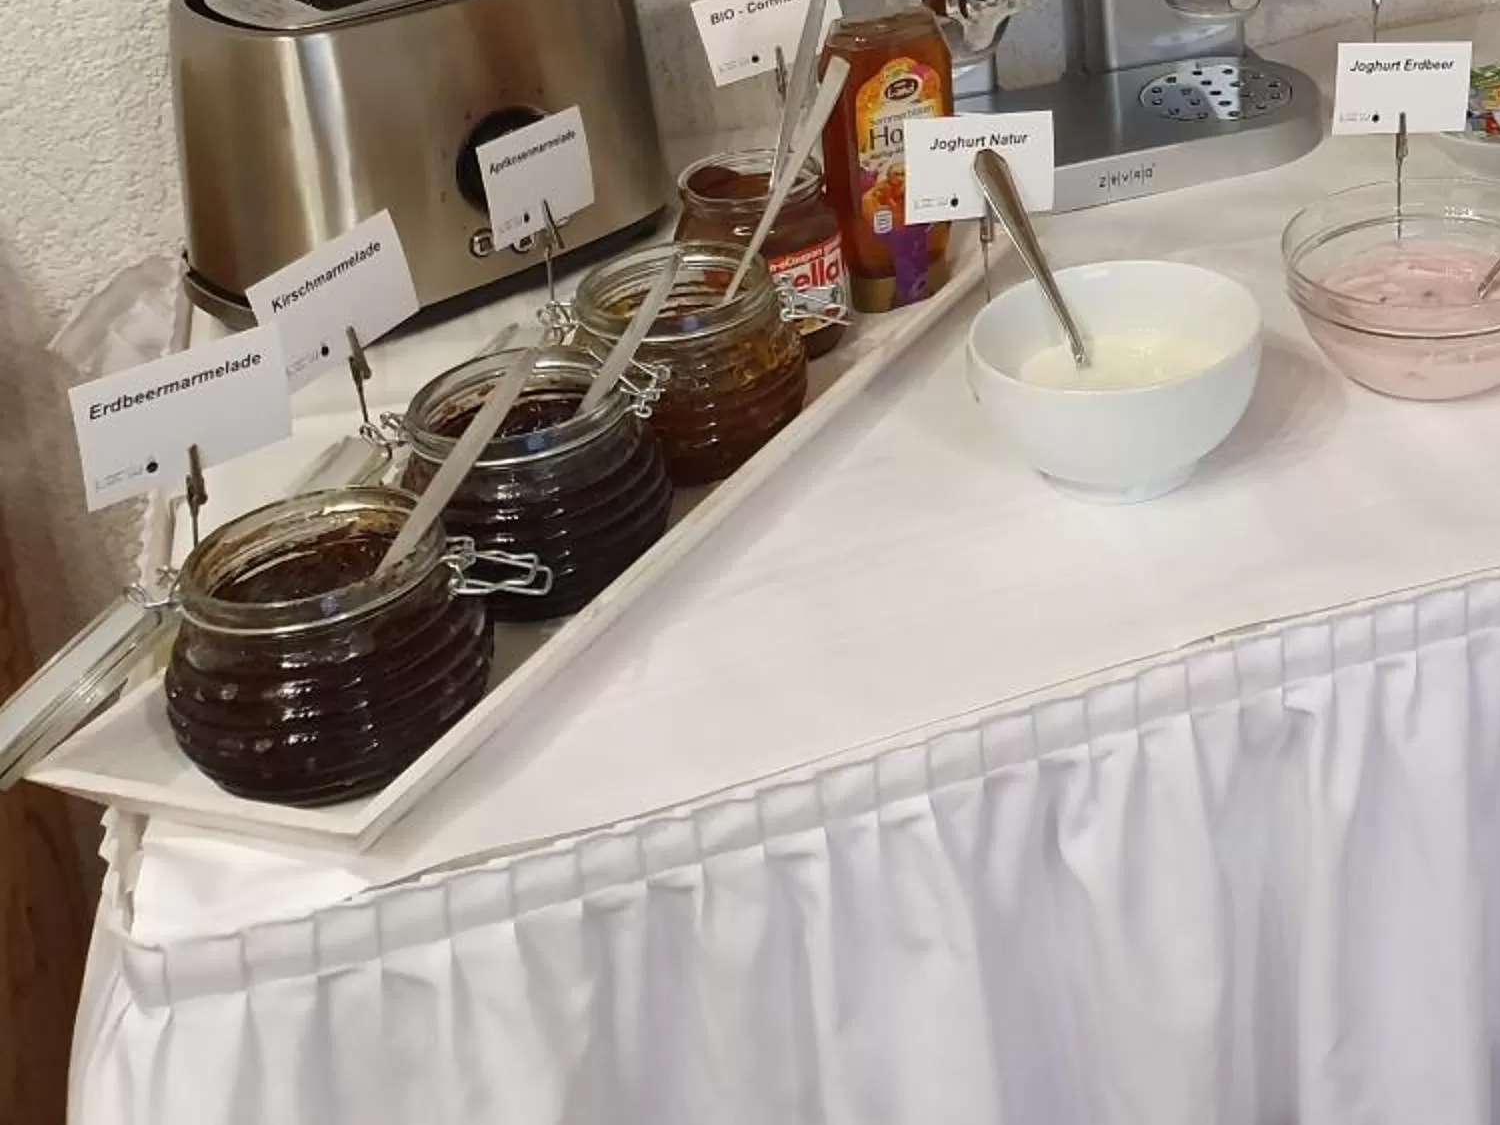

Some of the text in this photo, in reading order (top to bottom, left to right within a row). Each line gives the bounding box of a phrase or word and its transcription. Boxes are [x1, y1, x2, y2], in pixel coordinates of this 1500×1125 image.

[710, 7, 736, 26] BIO
[1349, 58, 1456, 74] Joghurt Erdbeer
[929, 132, 1029, 152] Joghurt Natur
[271, 240, 382, 314] Kirschmarmelade
[88, 352, 262, 421] Erdbeermarmelade
